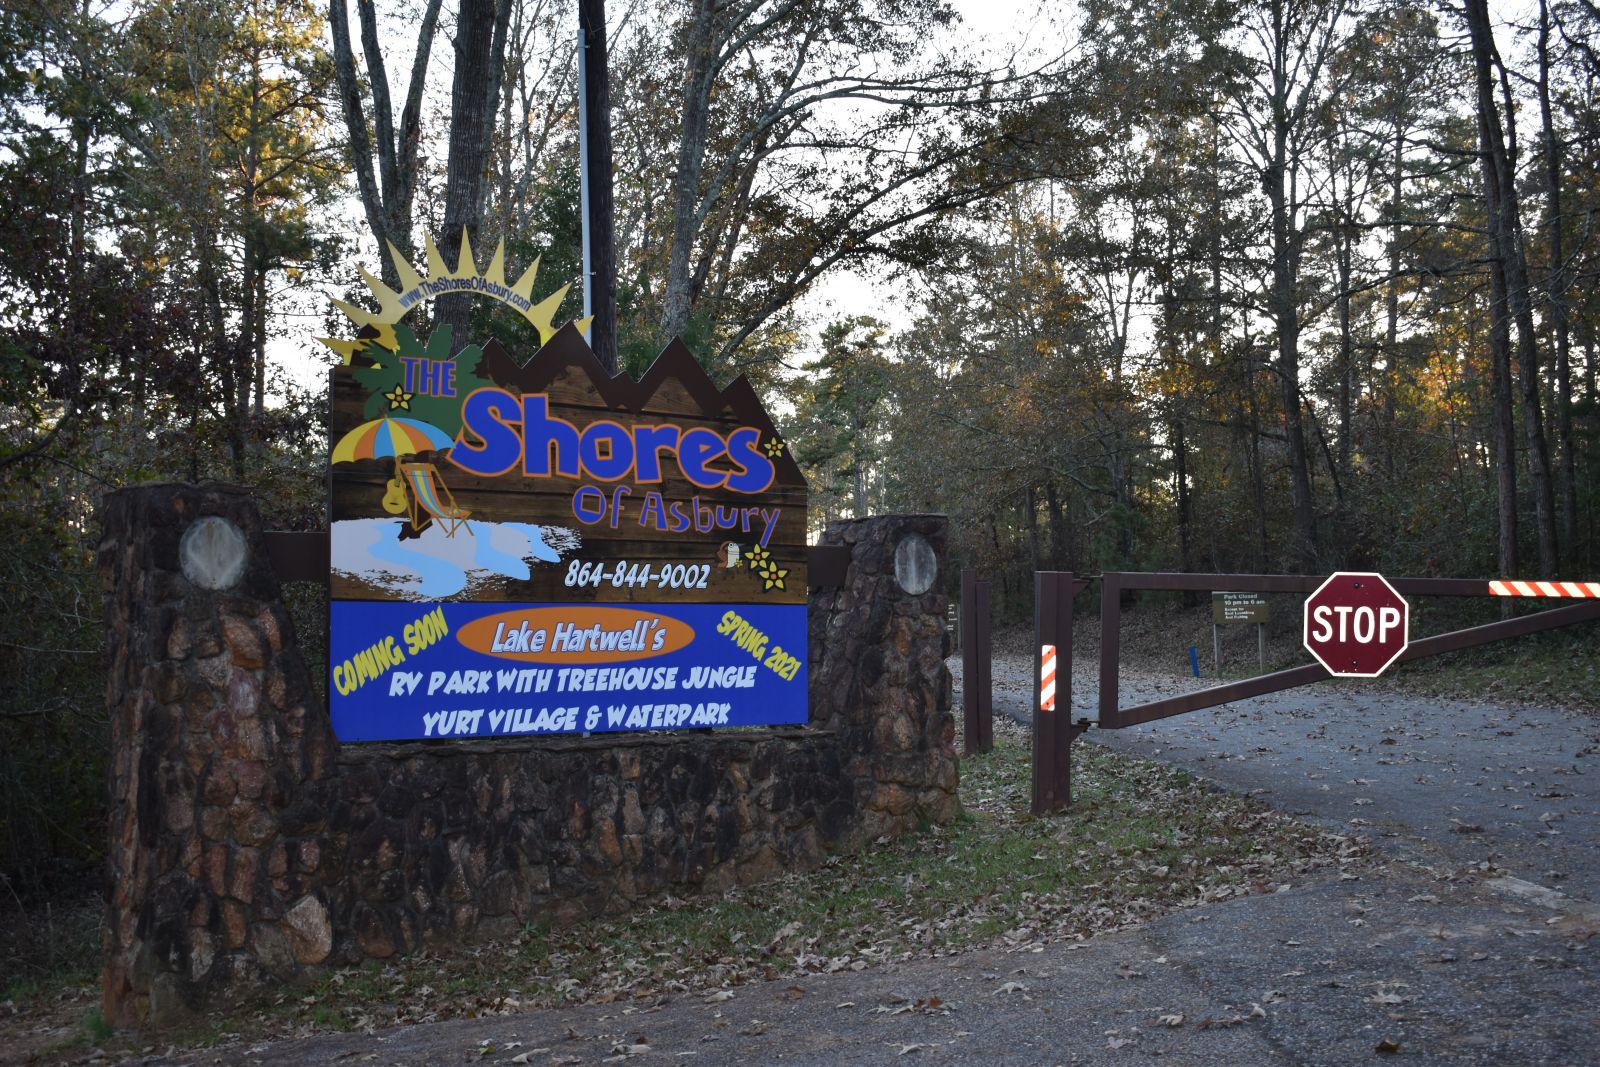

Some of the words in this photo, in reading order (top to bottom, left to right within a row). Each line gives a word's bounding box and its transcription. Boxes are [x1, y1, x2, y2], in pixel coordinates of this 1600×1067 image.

[398, 276, 531, 312] www.TheShoresOfAsbury.com
[400, 357, 457, 397] THE
[446, 387, 775, 494] Shores
[572, 485, 632, 529] Of
[639, 491, 781, 549] Asbury
[564, 559, 711, 589] 864-844-9002
[490, 620, 547, 653] Lake
[550, 618, 667, 652] Hartwell's
[1312, 605, 1400, 644] STOP
[333, 635, 406, 697] COMING
[403, 605, 449, 656] SOON
[717, 610, 769, 661] SPRING
[763, 646, 802, 681] 2021
[389, 671, 423, 696] RV
[427, 670, 493, 696] PARK
[496, 668, 554, 694] WITH
[557, 666, 678, 692] TREEHOUSE
[682, 665, 757, 689] JUNGLE
[422, 709, 484, 736] YURT
[488, 707, 579, 733] VILLAGE
[584, 705, 602, 730] &
[607, 702, 732, 728] WATERPARK
